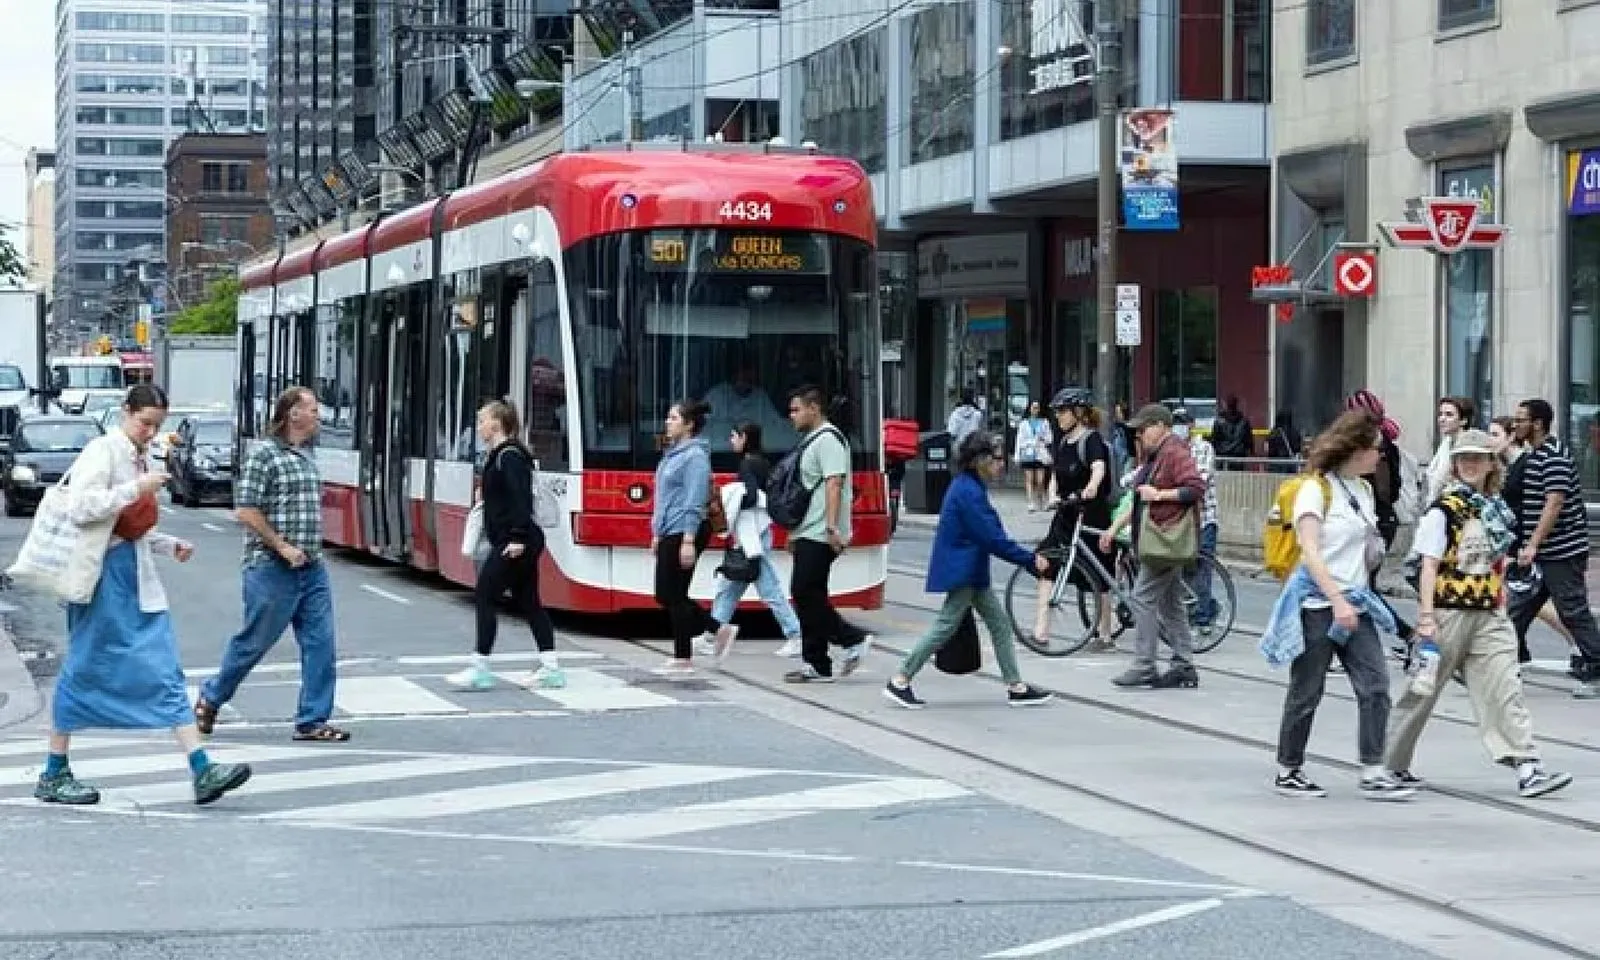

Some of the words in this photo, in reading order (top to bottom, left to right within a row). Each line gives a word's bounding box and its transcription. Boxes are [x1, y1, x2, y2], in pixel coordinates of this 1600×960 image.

[719, 201, 773, 221] 4434
[651, 239, 685, 262] 501
[733, 236, 783, 255] QUEEN
[740, 255, 802, 269] DUNDAS
